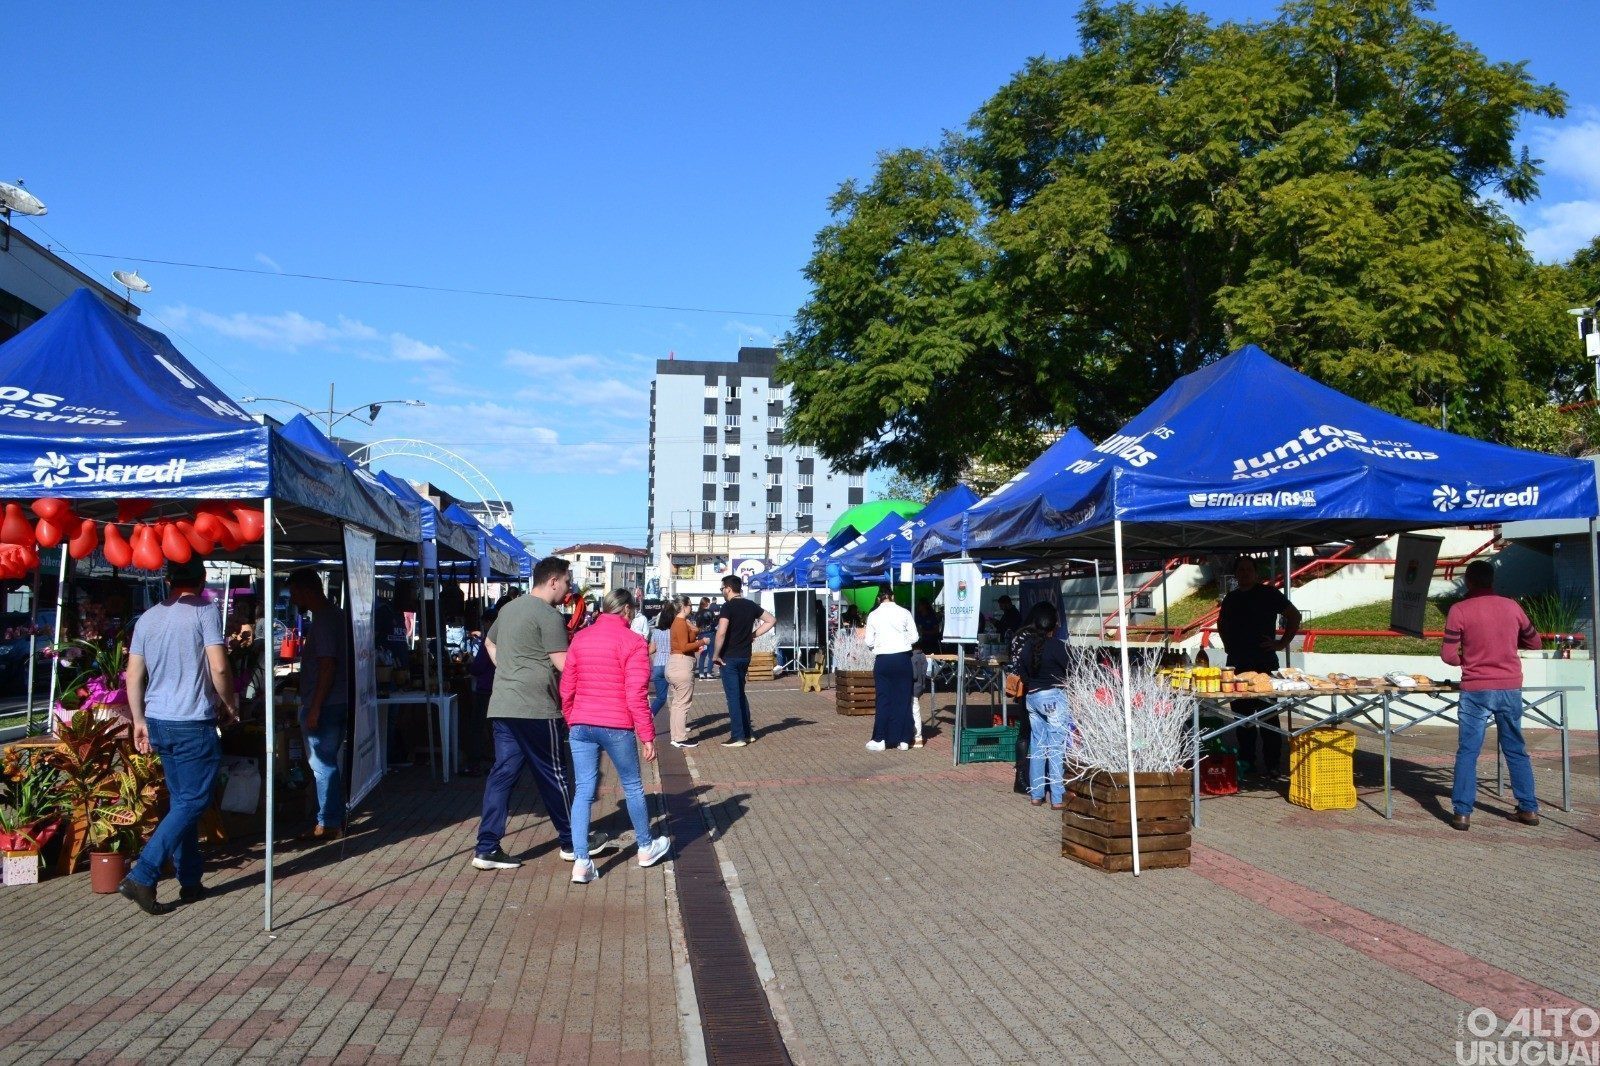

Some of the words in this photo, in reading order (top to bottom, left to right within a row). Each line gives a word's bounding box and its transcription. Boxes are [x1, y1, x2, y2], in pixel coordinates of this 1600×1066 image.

[60, 405, 120, 416] pelas
[1231, 437, 1440, 481] Agroindústrias
[1233, 424, 1368, 474] Juntos
[1372, 439, 1412, 448] pelas
[75, 456, 187, 483] Sicredi
[1207, 491, 1300, 507] EMATER/RS
[1462, 486, 1539, 508] Sicredi
